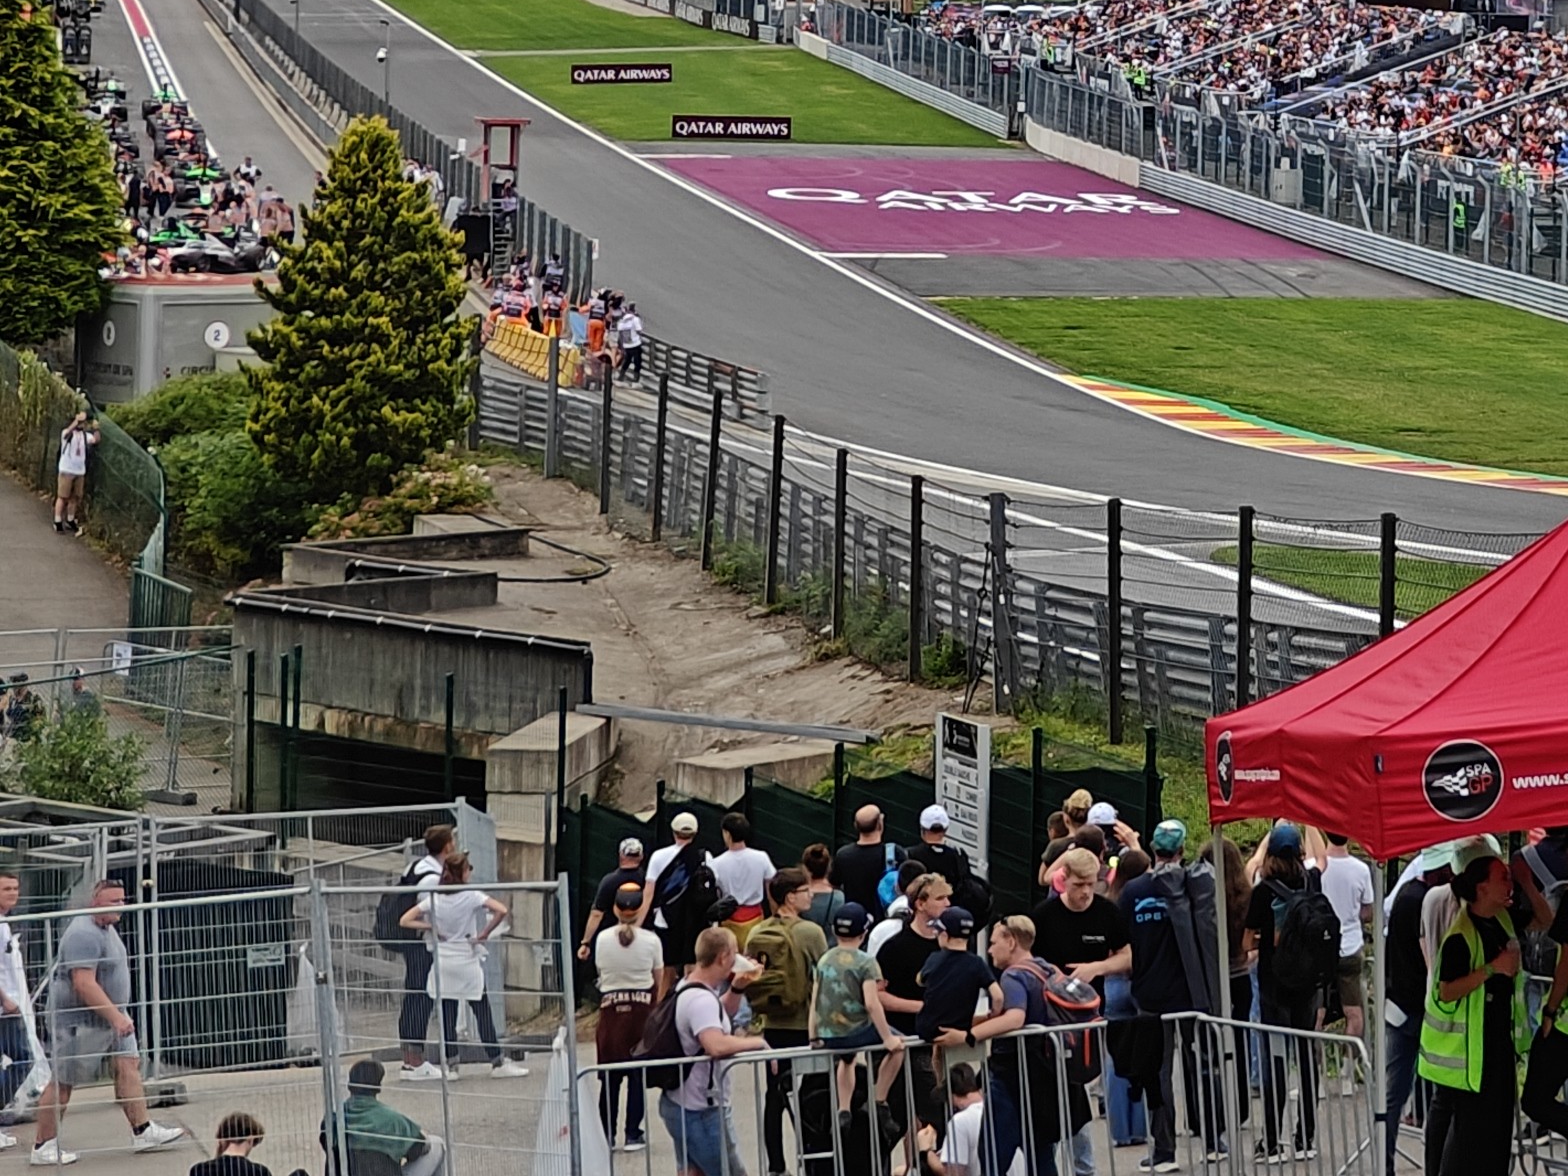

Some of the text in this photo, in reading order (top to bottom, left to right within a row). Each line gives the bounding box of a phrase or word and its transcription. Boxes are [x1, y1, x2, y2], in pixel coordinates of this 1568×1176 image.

[573, 67, 671, 83] QATAR AIRWAYS
[675, 120, 789, 137] QATAR AIRWAYS
[767, 187, 1162, 206] QATAR
[878, 200, 1181, 215] AIRWAYS
[1465, 761, 1492, 776] SPA
[1468, 774, 1493, 794] GP
